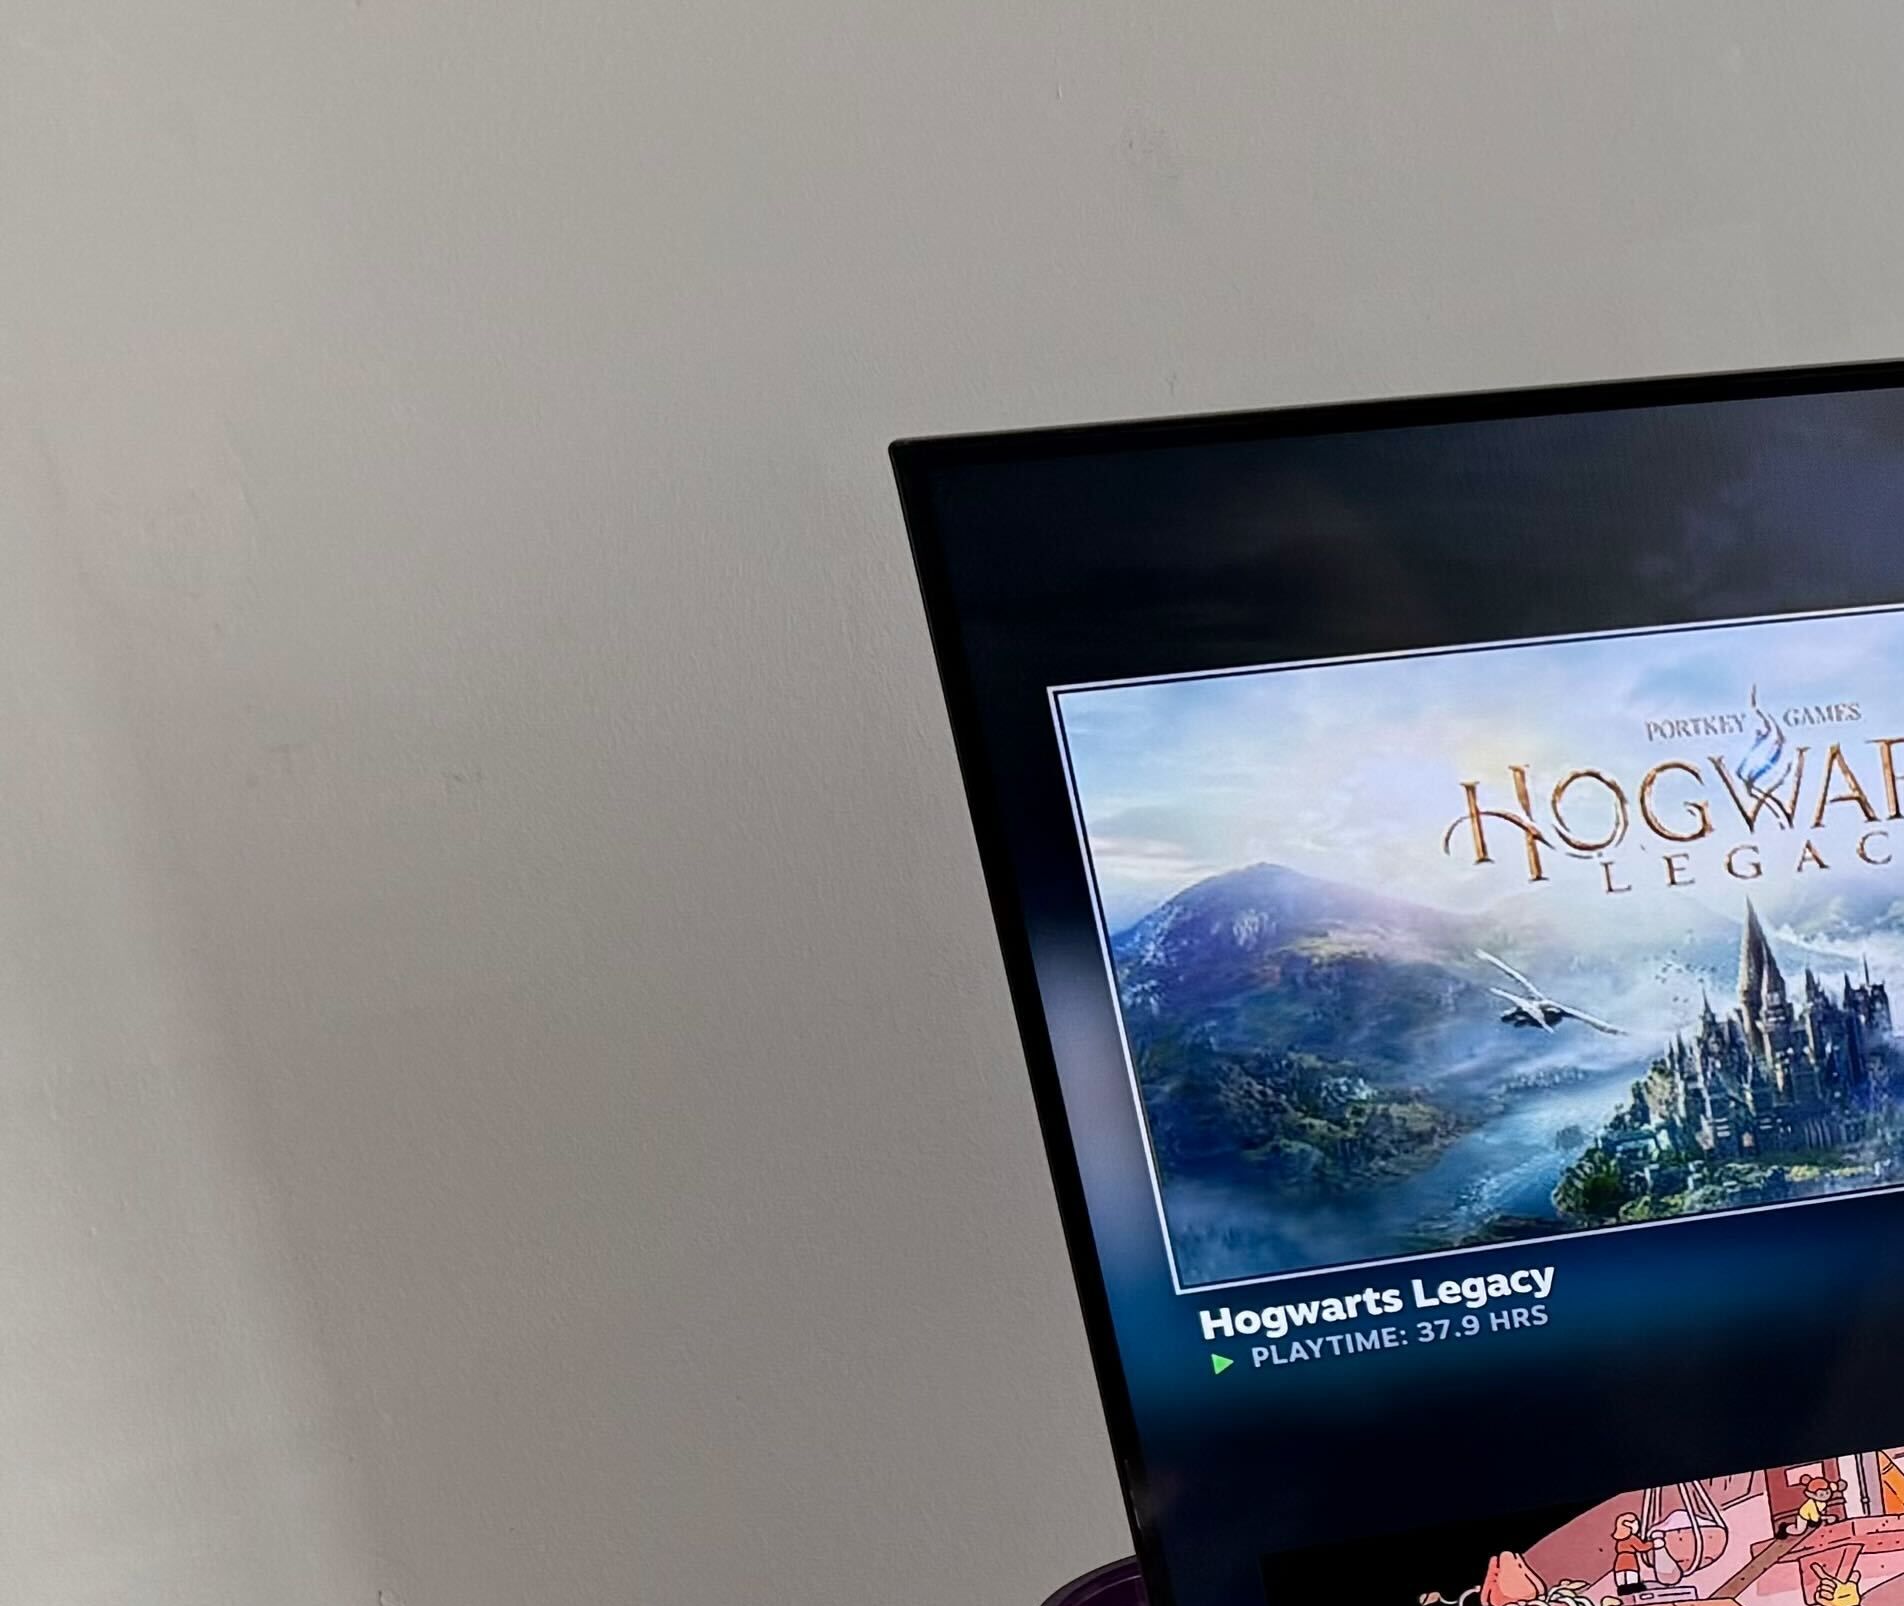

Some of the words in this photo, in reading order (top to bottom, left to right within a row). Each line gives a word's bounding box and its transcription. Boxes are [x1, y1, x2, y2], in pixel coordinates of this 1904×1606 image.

[1645, 713, 1747, 742] PORTKEY
[1783, 702, 1862, 728] GAMES
[1200, 1287, 1403, 1340] Hogwarts
[1412, 1267, 1555, 1310] Legacy
[1252, 1327, 1408, 1368] PLAYTIME:
[1417, 1315, 1480, 1343] 37.9
[1490, 1305, 1549, 1332] HRS
